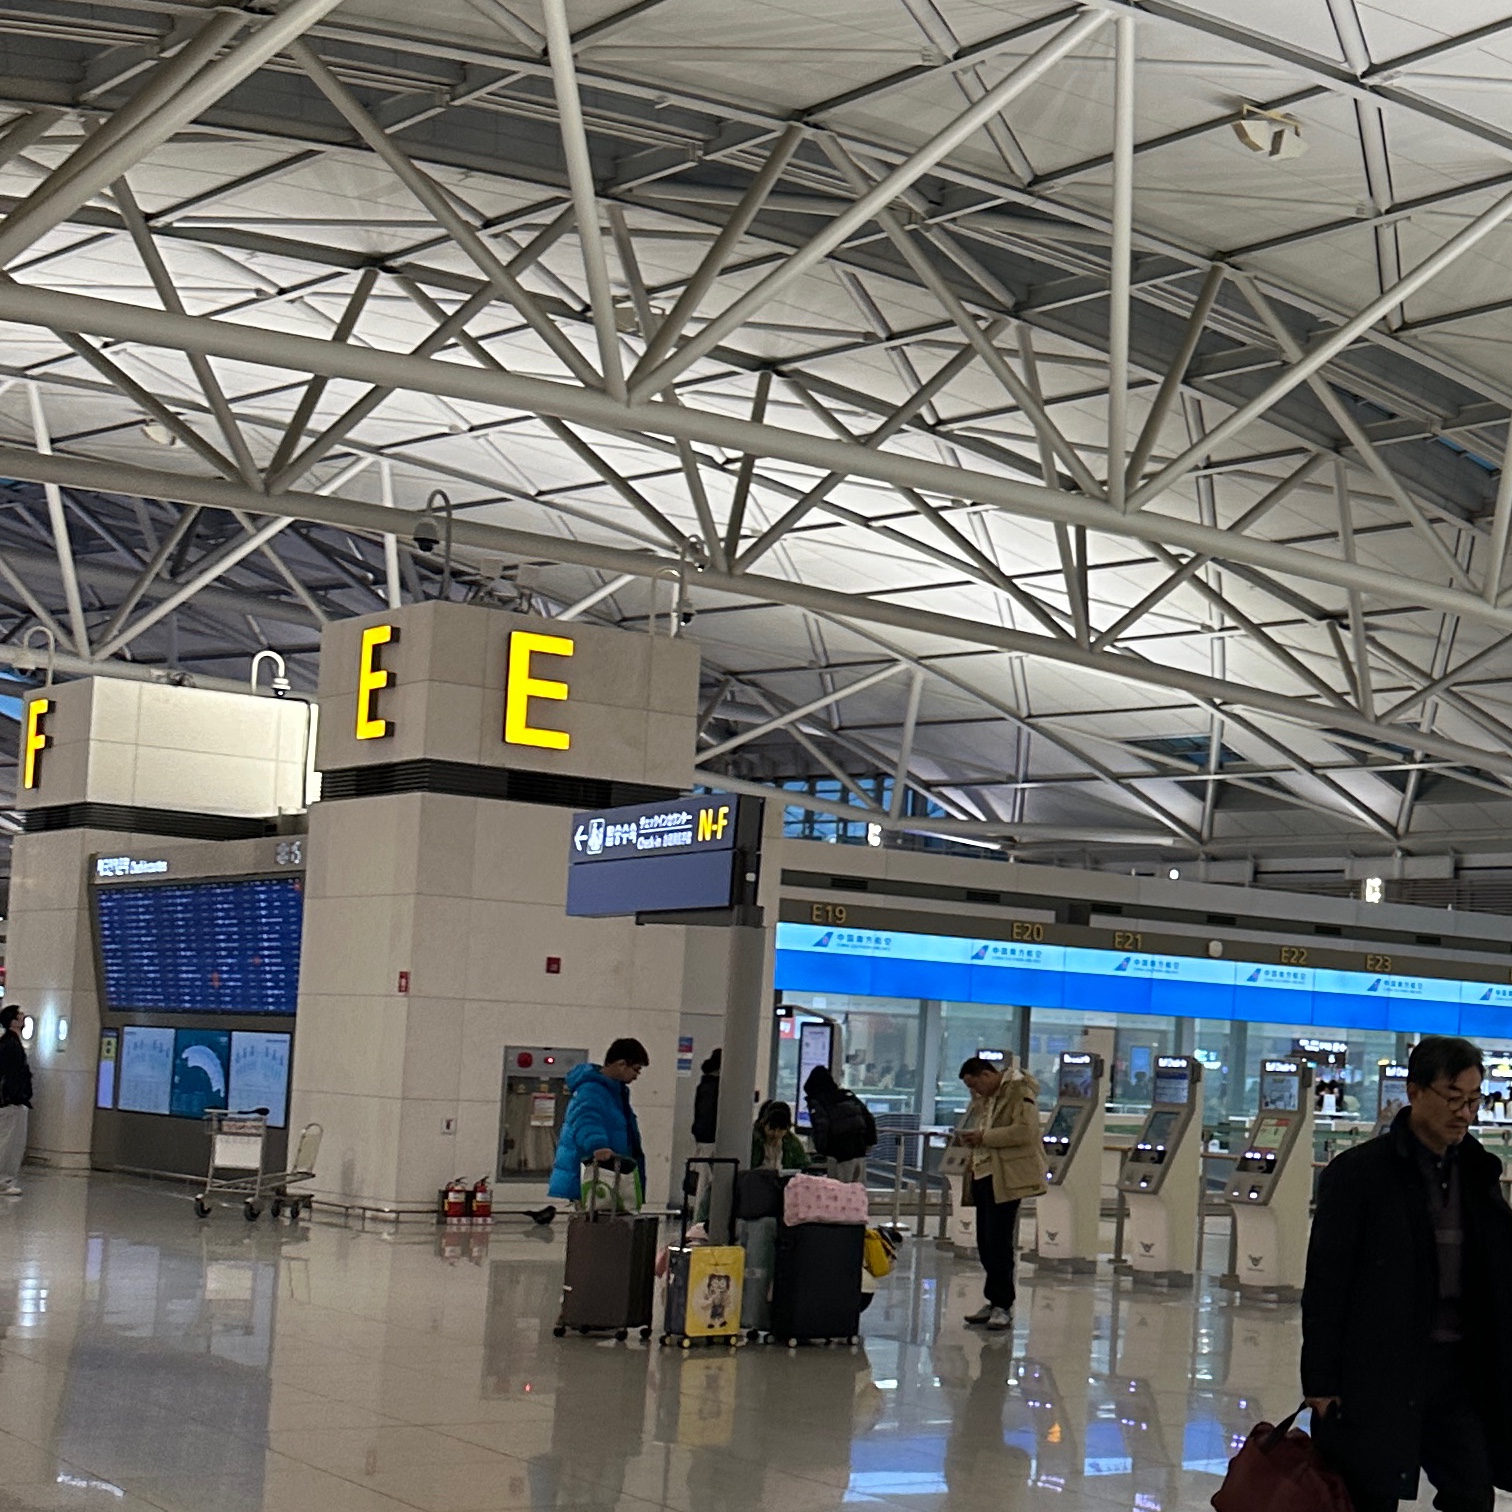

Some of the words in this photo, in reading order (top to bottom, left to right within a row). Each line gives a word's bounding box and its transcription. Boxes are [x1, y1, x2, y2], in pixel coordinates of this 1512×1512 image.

[355, 625, 392, 740] E
[504, 630, 574, 751] E
[24, 698, 49, 790] F
[812, 903, 847, 924] E19
[1012, 922, 1044, 942] E20
[1114, 931, 1143, 950] E21
[1280, 946, 1309, 965] E22
[1365, 953, 1393, 972] E23
